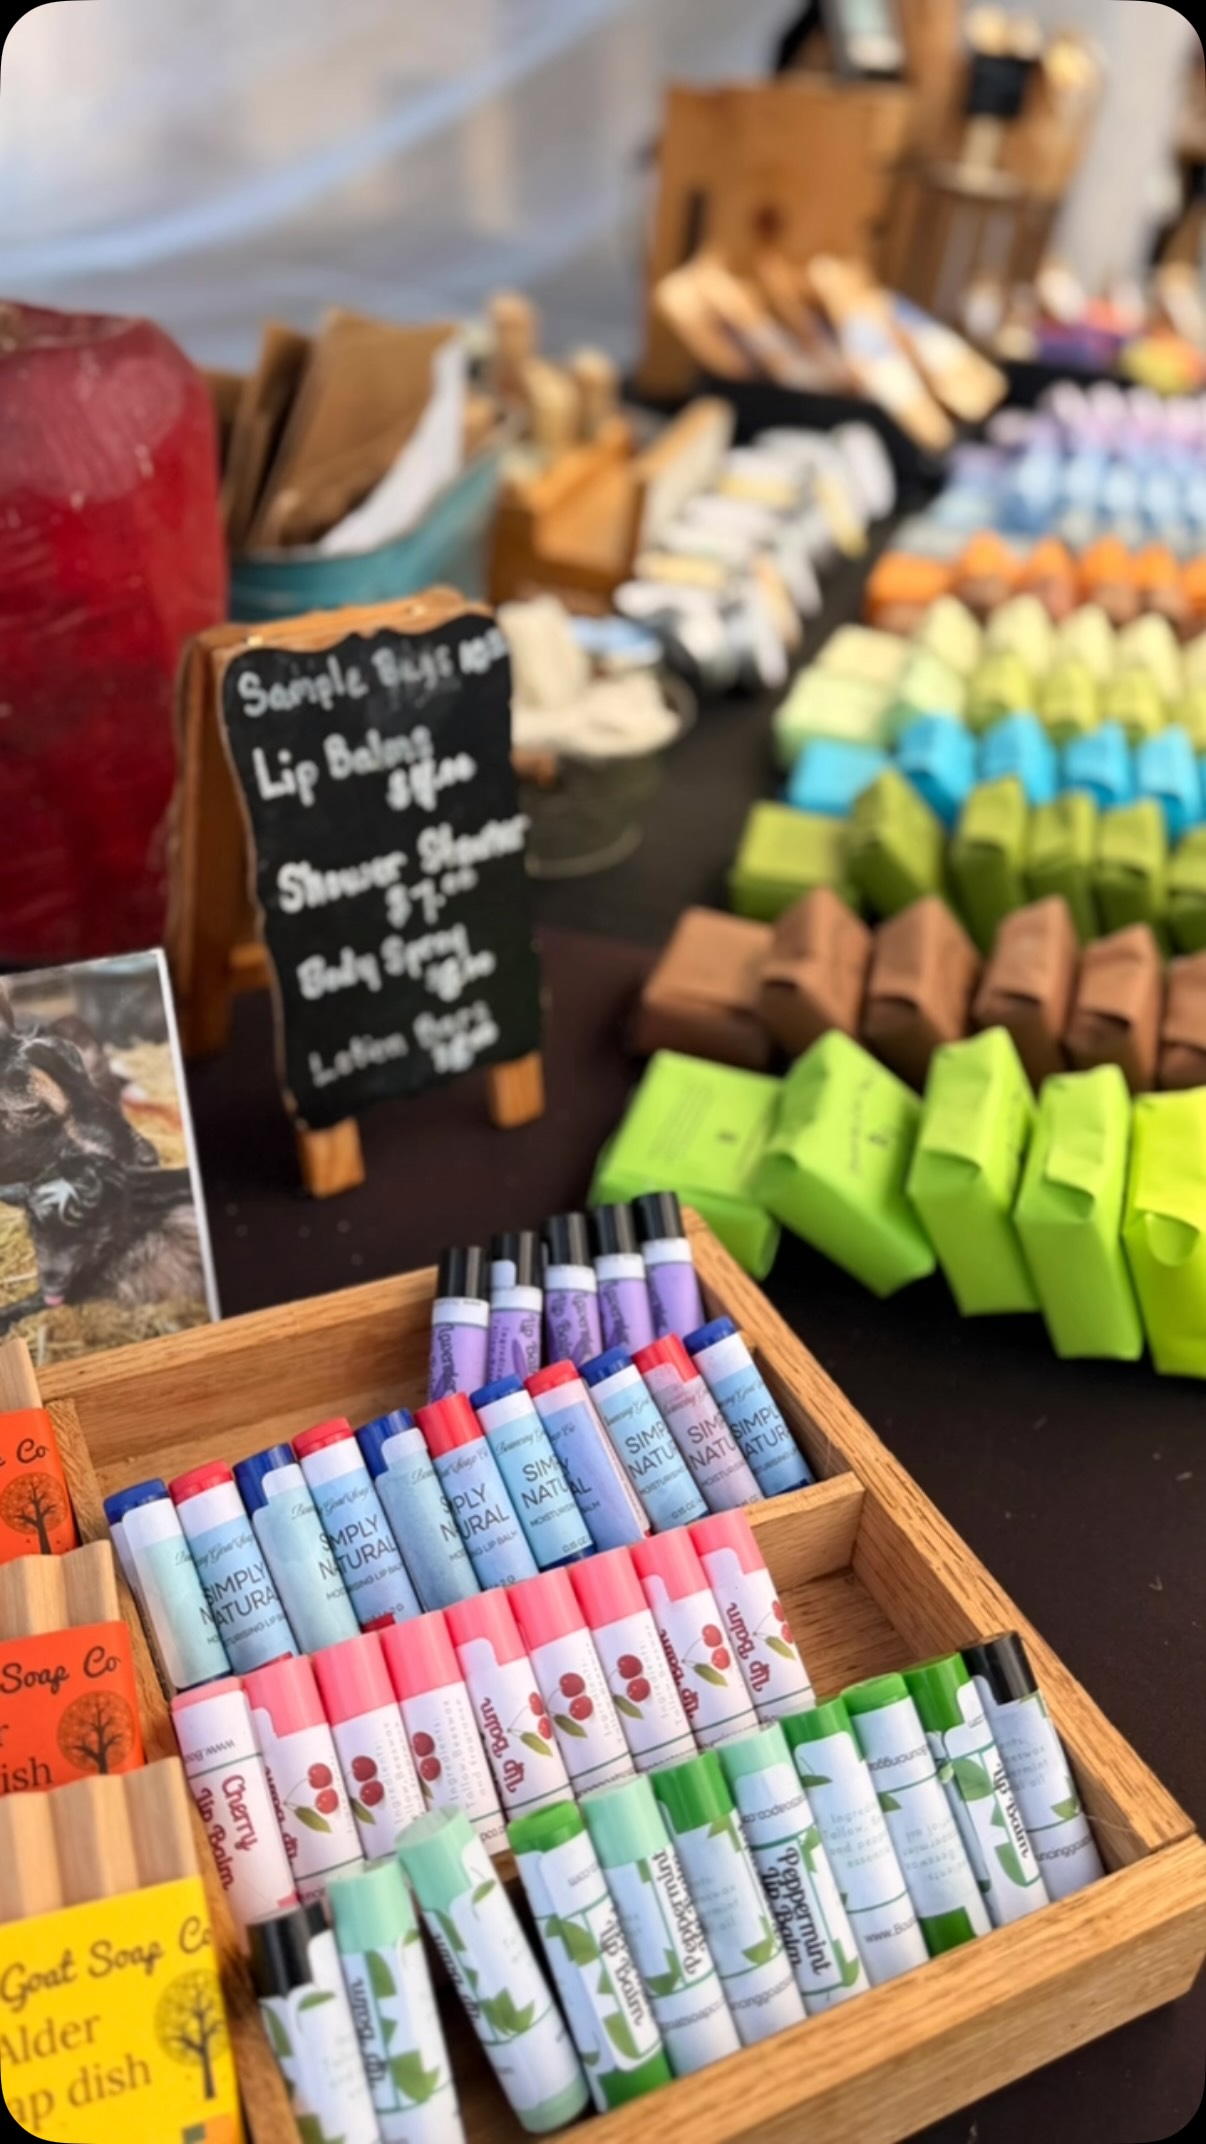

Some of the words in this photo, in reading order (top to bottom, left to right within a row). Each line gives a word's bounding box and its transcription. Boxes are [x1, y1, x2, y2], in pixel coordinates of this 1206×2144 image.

[252, 745, 319, 807] Lip
[276, 851, 408, 914] Shower
[296, 945, 383, 1000] Body
[16, 1438, 49, 1464] Co
[0, 1662, 70, 1695] Soap
[83, 1645, 121, 1678] Co
[221, 1774, 259, 1851] Cherry
[777, 1846, 832, 1976] Peppermint
[0, 1949, 77, 2013] Goat
[87, 1939, 165, 1977] Soap
[0, 2015, 101, 2068] Alder
[67, 2053, 153, 2107] dish
